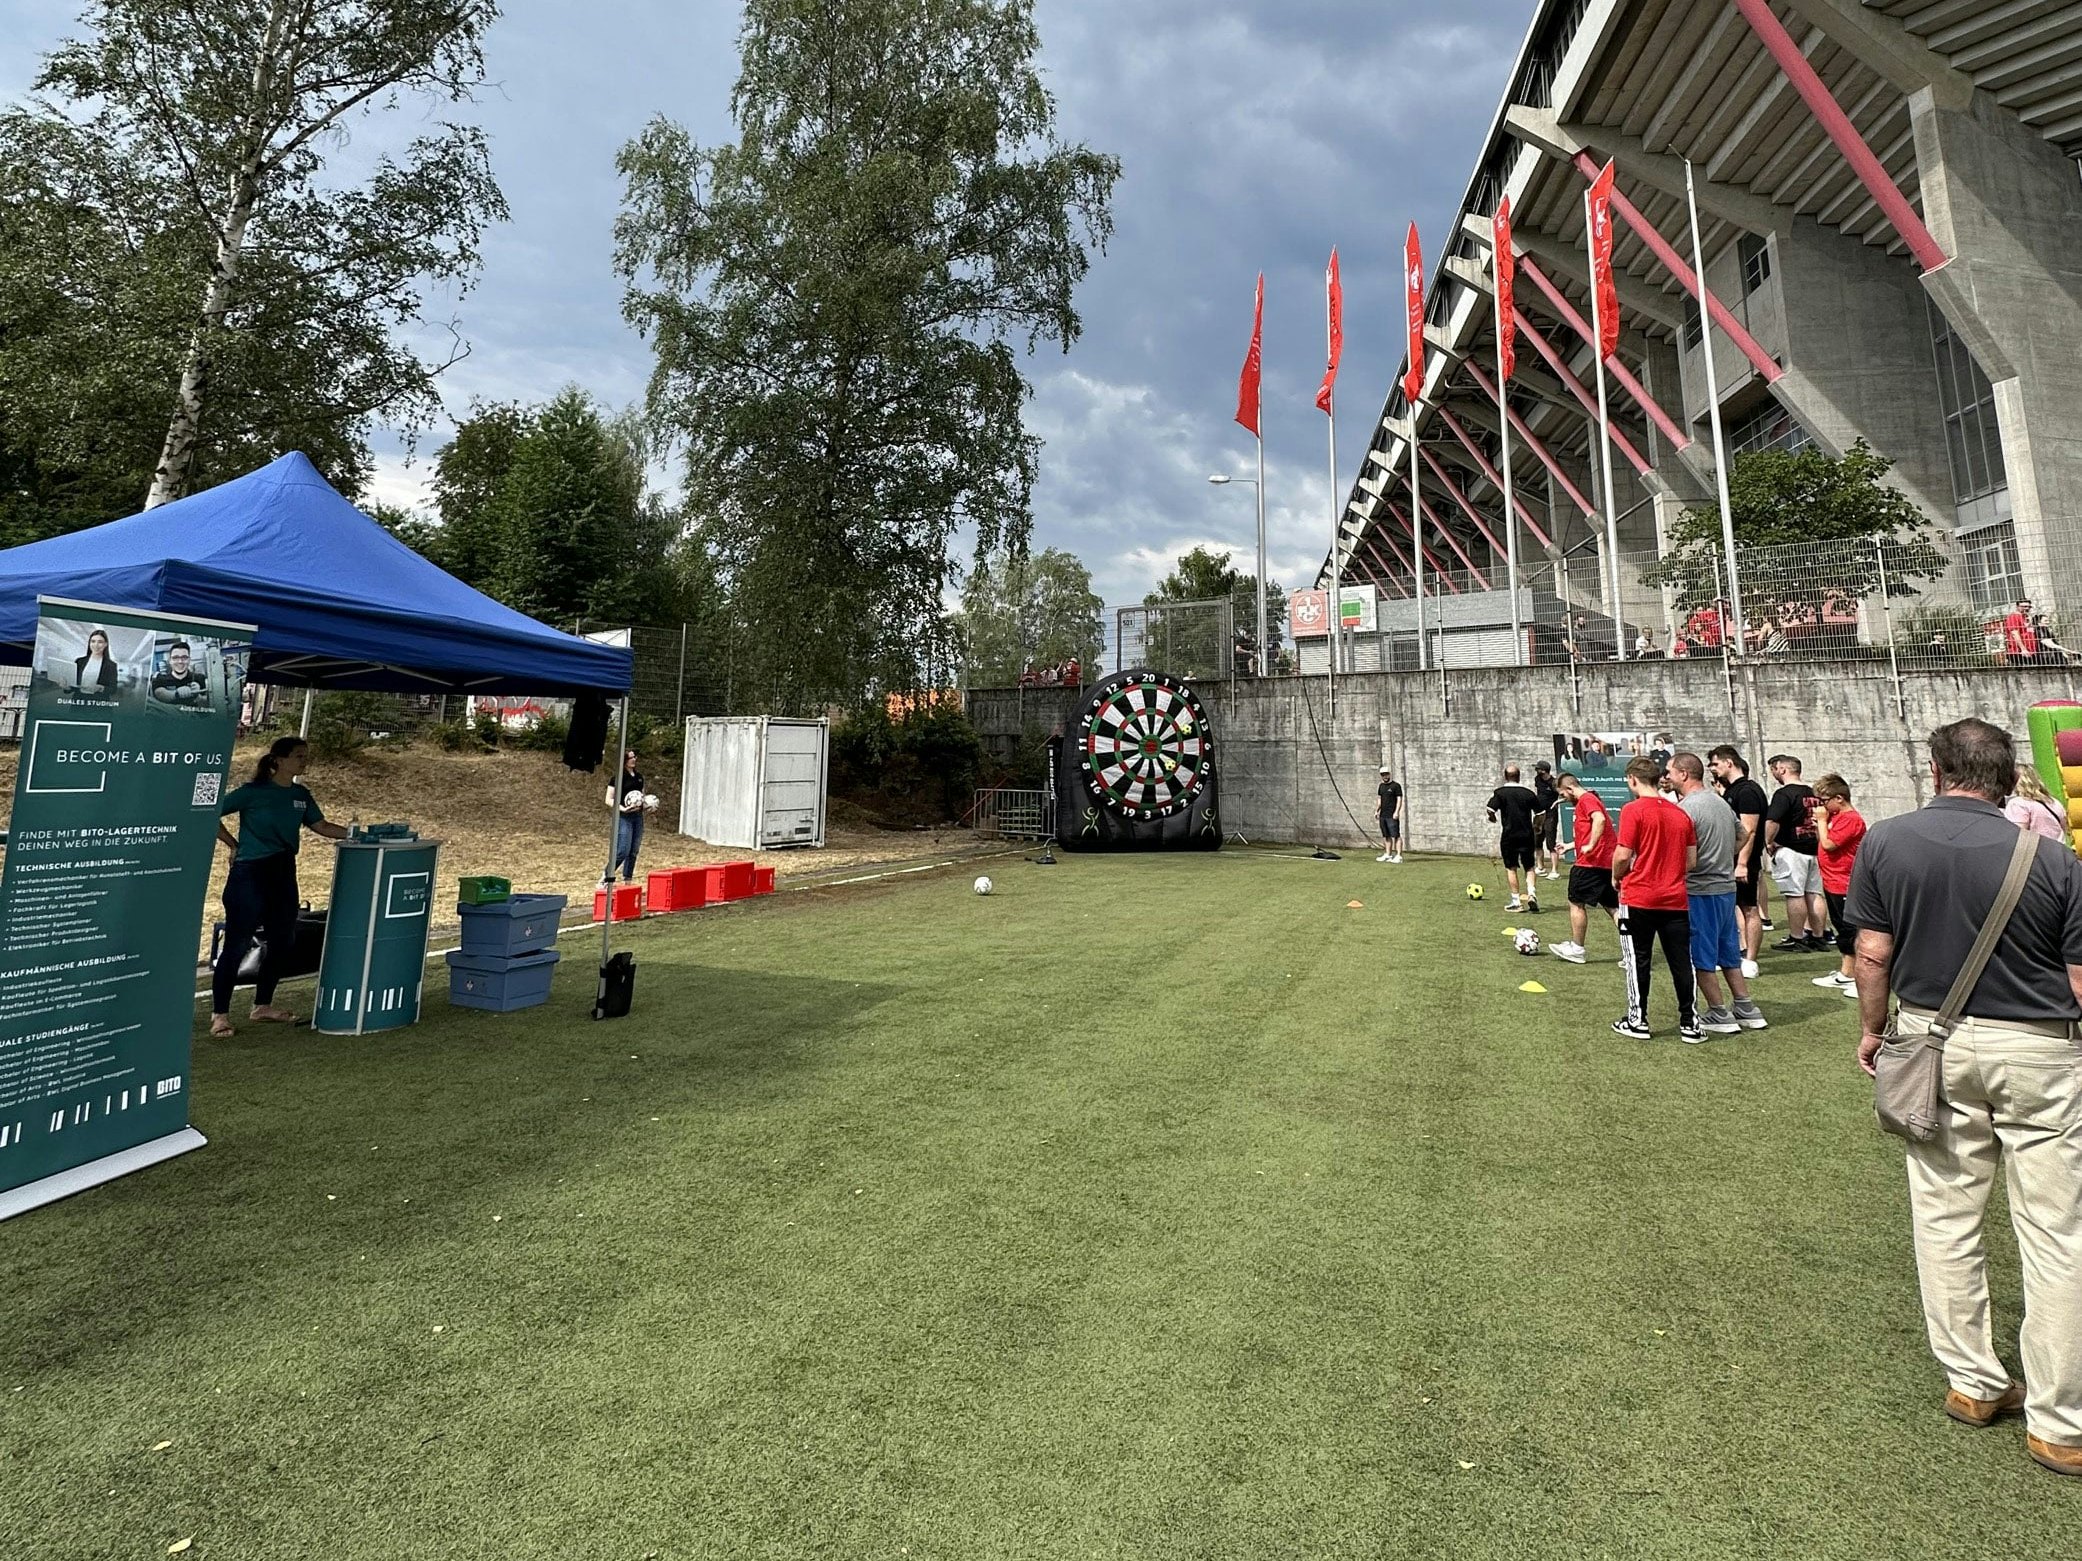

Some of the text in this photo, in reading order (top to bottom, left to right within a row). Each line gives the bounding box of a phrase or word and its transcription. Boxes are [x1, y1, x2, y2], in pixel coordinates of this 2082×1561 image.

[1126, 678, 1134, 686] 5
[1142, 673, 1156, 683] 20
[1164, 678, 1170, 687] 1
[1105, 683, 1120, 695] 12
[1178, 685, 1190, 698] 18
[57, 698, 120, 707] DUALES STUDIUM
[1093, 699, 1101, 708] 9
[1081, 714, 1093, 728] 14
[1199, 718, 1209, 732] 13
[1078, 738, 1088, 751] 11
[56, 750, 224, 765] BECOME A BIT OF US.
[1082, 762, 1091, 770] 8
[1201, 761, 1210, 776] 10
[1090, 781, 1101, 795] 16
[1192, 782, 1203, 795] 15
[1180, 798, 1189, 808] 2
[1122, 807, 1136, 817] 19
[1144, 810, 1151, 820] 3
[1161, 806, 1173, 815] 17
[19, 825, 178, 840] FINDE MIT BITO-LAGERTECHNIK
[17, 840, 60, 851] DEINEN
[64, 839, 89, 848] WEG
[91, 838, 102, 847] IN
[104, 838, 120, 846] DIE
[15, 862, 72, 872] TECHNISCHE
[74, 859, 125, 868] AUSBILDUNG
[13, 905, 46, 913] Fachkraft
[0, 954, 126, 978] KAUFMÄNNISCHE AUSBILDUNG
[0, 1037, 23, 1047] UALE
[25, 1022, 90, 1042] STUDIENGÄNGE
[157, 1075, 181, 1095] BITO
